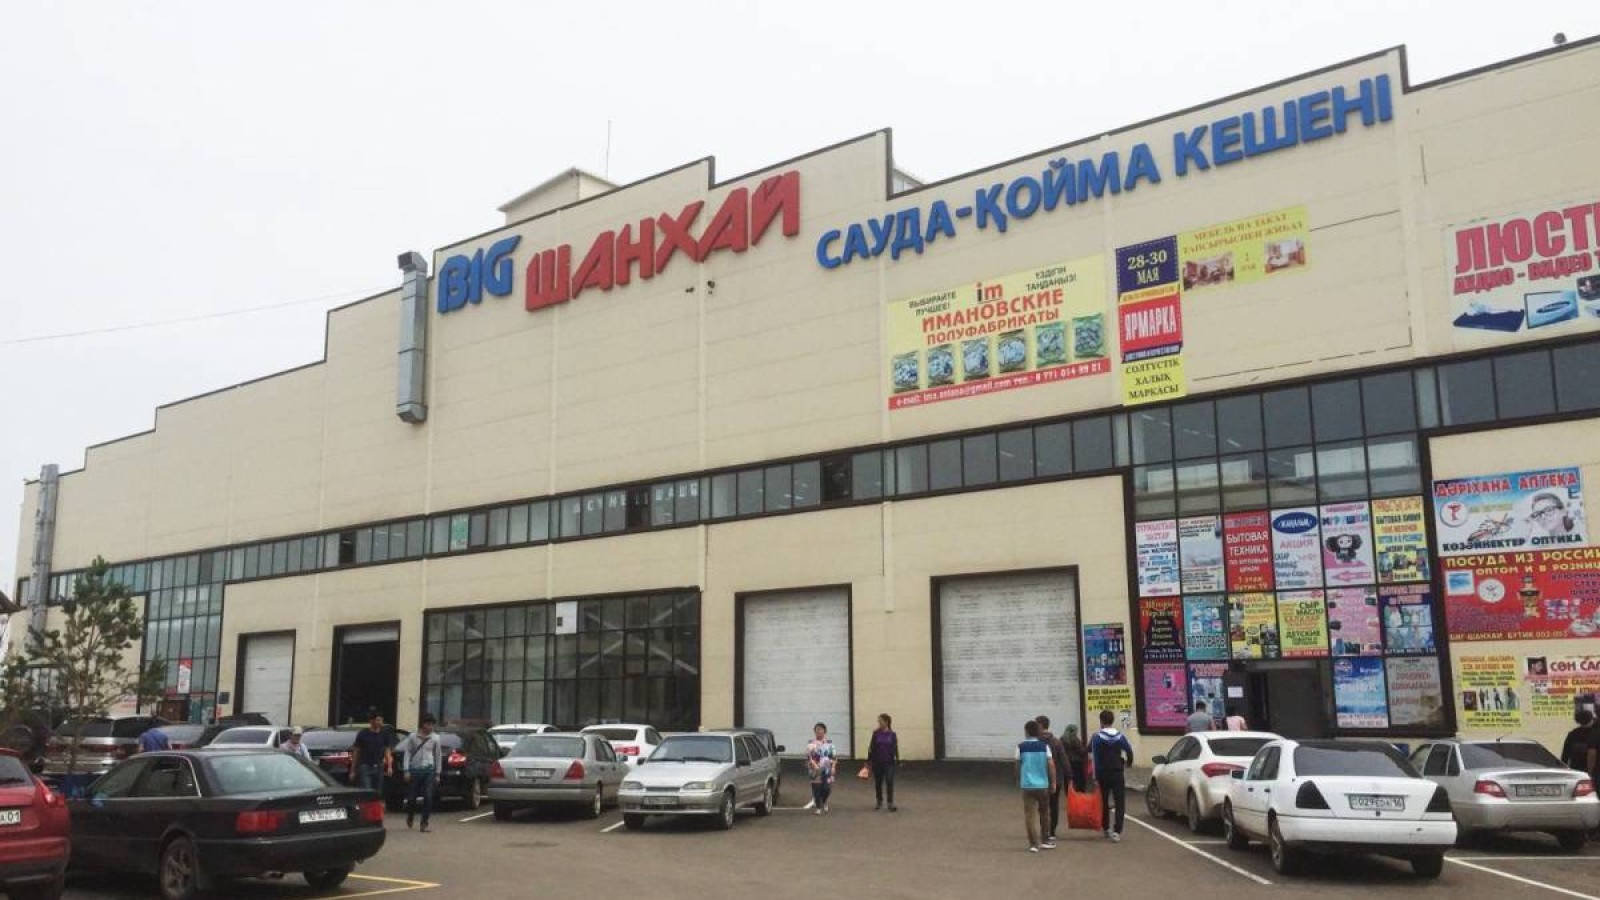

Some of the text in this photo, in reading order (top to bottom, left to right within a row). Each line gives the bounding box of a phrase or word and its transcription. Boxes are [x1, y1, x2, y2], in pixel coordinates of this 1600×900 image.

[1173, 73, 1393, 177] КЕШЕНІ
[437, 170, 800, 314] BIG ШАНХАЙ
[1127, 249, 1168, 271] 28-30
[1136, 269, 1160, 285] МАЯ
[908, 291, 957, 309] ВЫБИРАЙТЕ
[976, 281, 1004, 303] im
[922, 288, 1064, 333] ИМАНОВСКИЕ
[926, 307, 1060, 346] ПОЛУФАБРИКАТЫ
[1124, 304, 1177, 341] ЯРМАРКА
[1128, 384, 1180, 400] МАРКАСЫ
[1518, 472, 1578, 490] АПТЕКА
[1226, 531, 1269, 543] БЫТОВАЯ
[1531, 534, 1583, 545] ОПТИКА
[1228, 544, 1268, 556] ТЕХНИКА
[1445, 554, 1507, 568] ПОСУДА
[1515, 552, 1535, 564] ИЗ
[1299, 601, 1320, 609] СЫР
[1286, 630, 1321, 639] ДЕТСКИЕ
